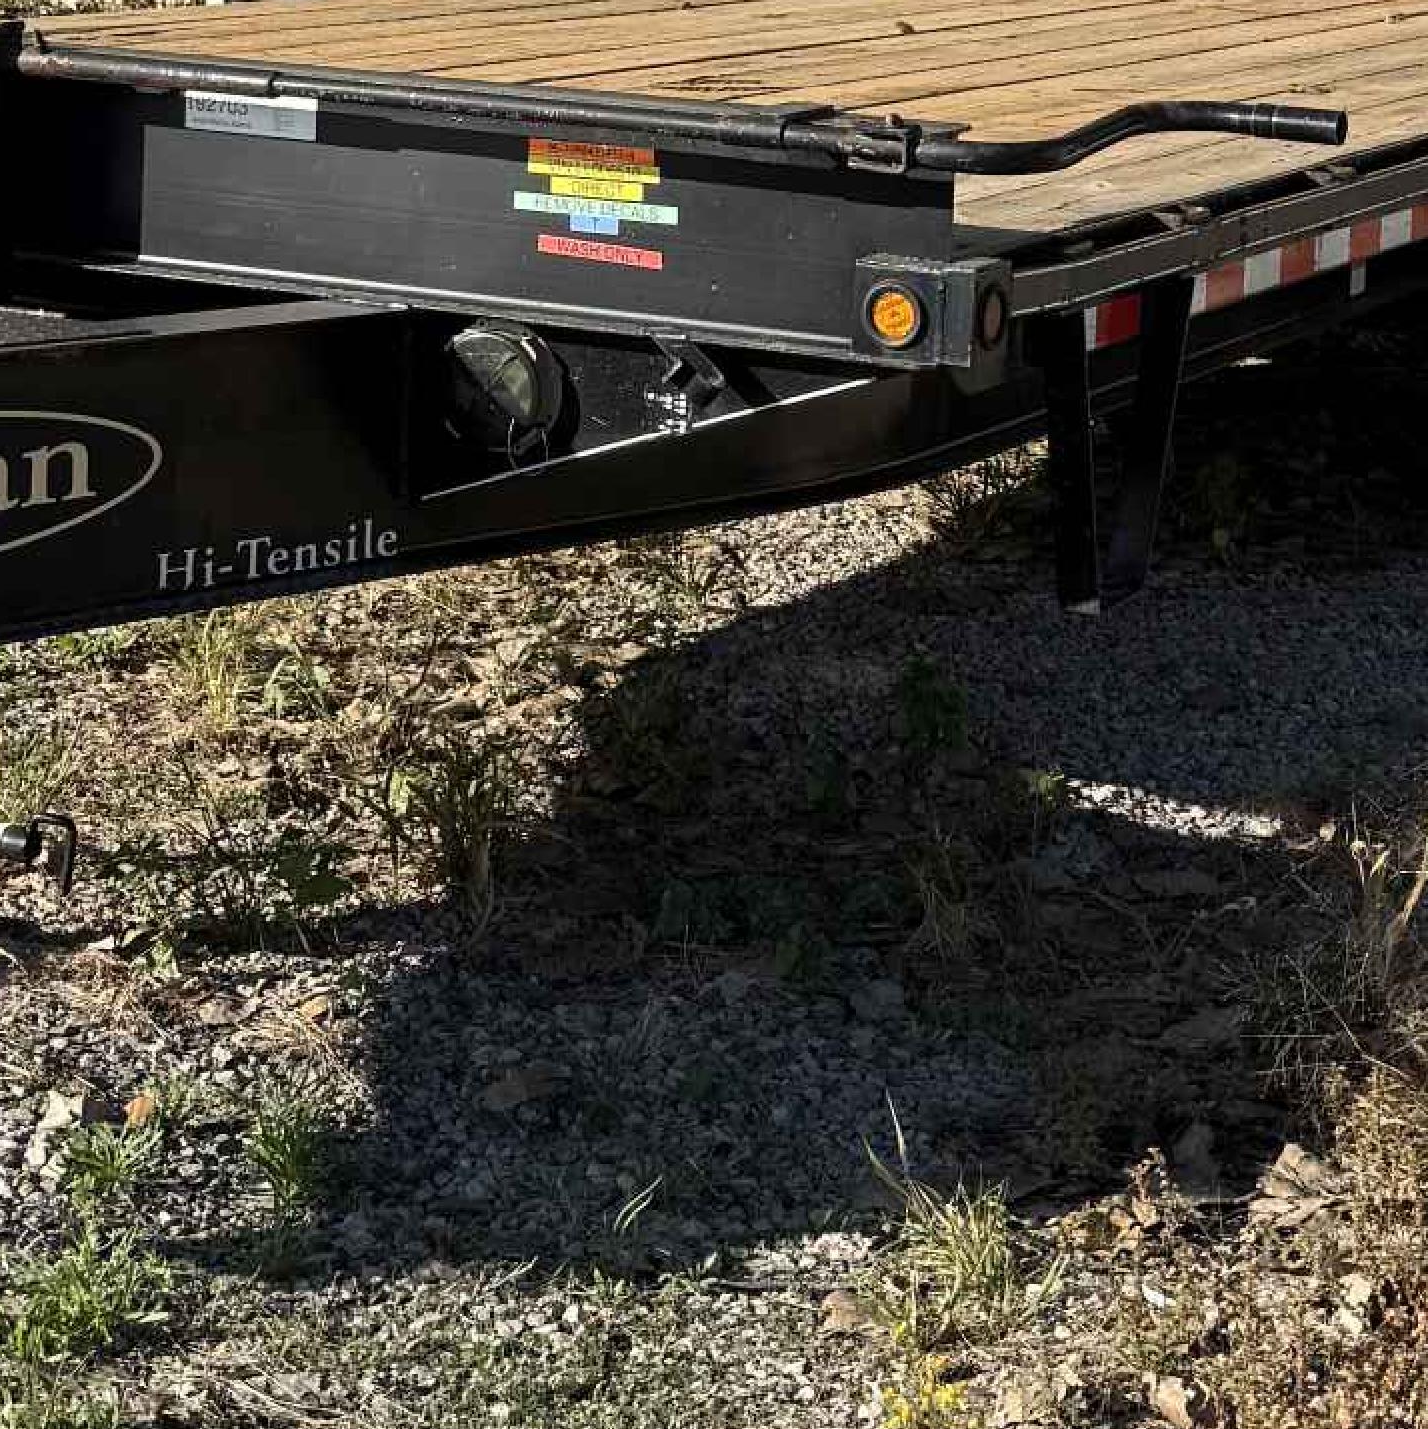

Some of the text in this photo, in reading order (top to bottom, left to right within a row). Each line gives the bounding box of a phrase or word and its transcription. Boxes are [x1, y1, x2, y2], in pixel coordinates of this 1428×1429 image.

[557, 238, 642, 263] WASH ONLY
[157, 518, 398, 591] Hi-Tensile
